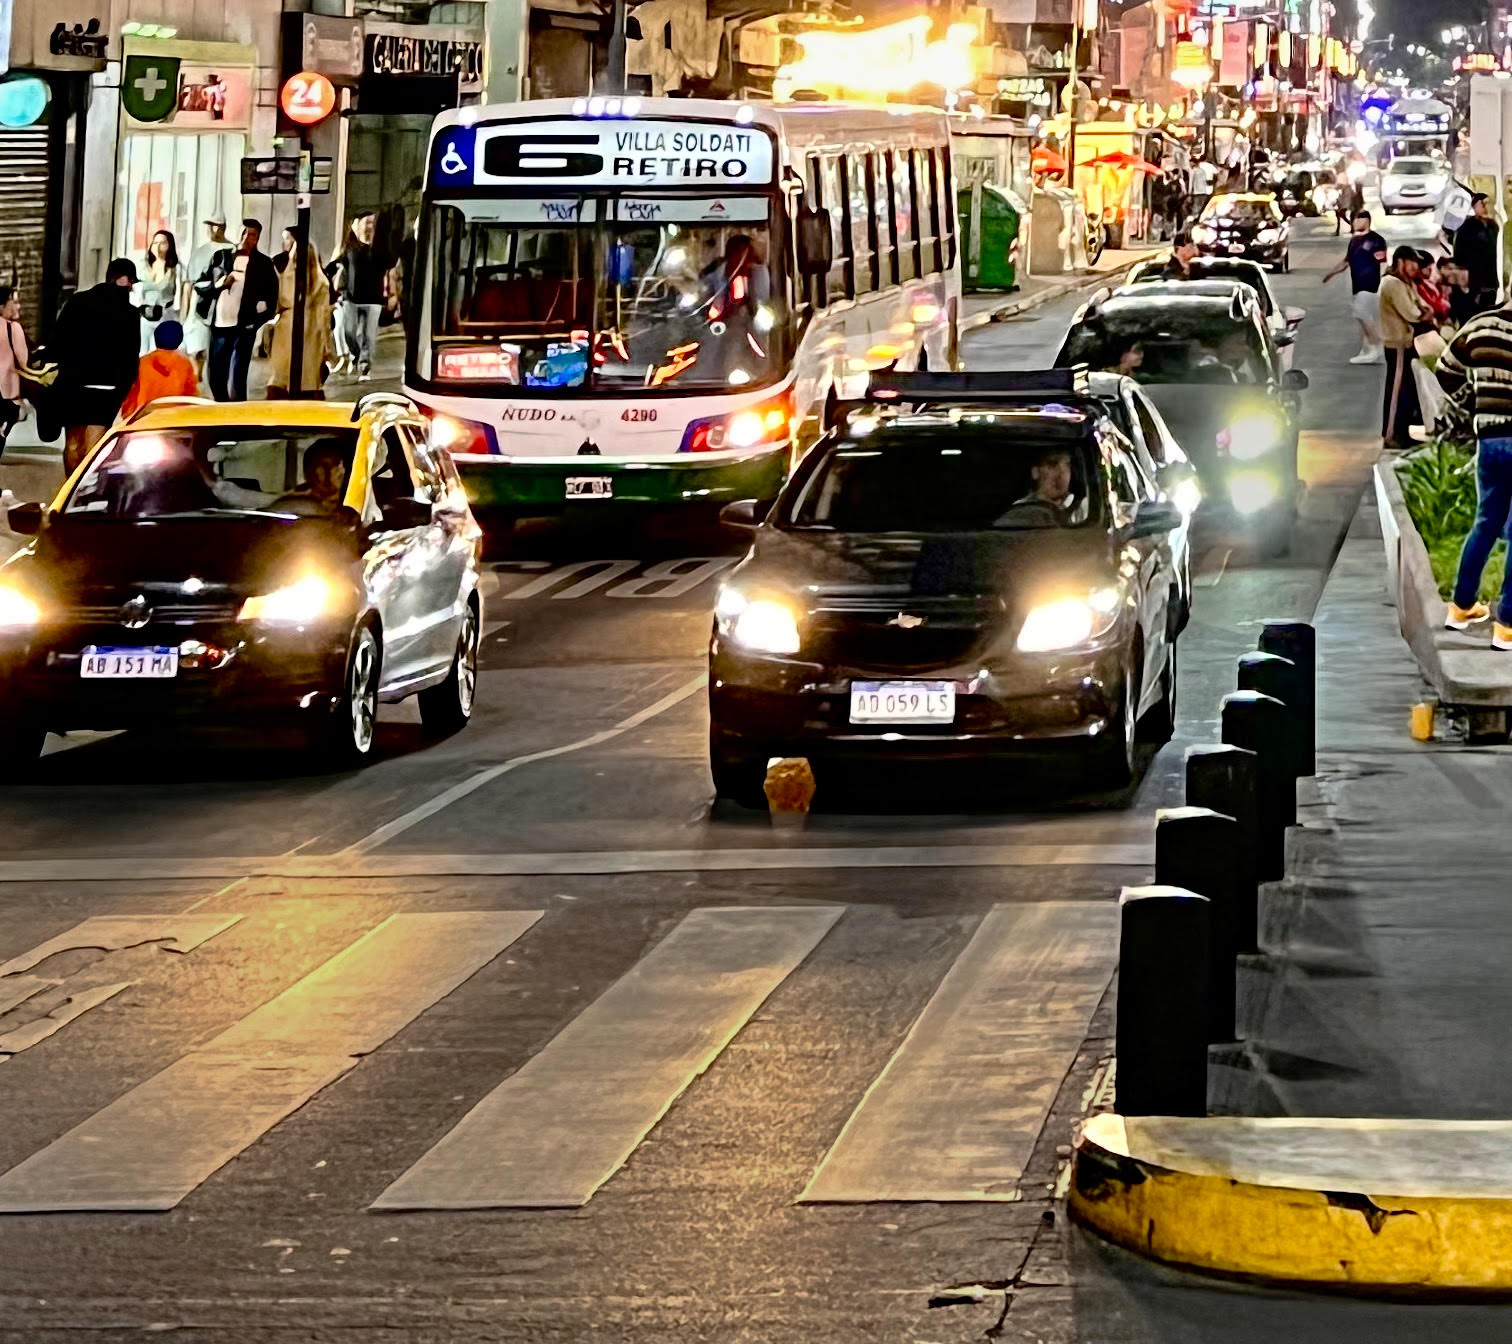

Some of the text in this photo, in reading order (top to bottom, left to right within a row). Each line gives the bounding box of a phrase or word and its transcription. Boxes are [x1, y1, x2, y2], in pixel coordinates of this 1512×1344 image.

[288, 79, 323, 103] 24
[616, 132, 752, 154] VILLA SOLDATI
[483, 134, 604, 177] 6
[613, 158, 748, 178] RETIRO
[113, 656, 145, 674] 151
[857, 694, 879, 713] AD
[886, 694, 919, 713] 059
